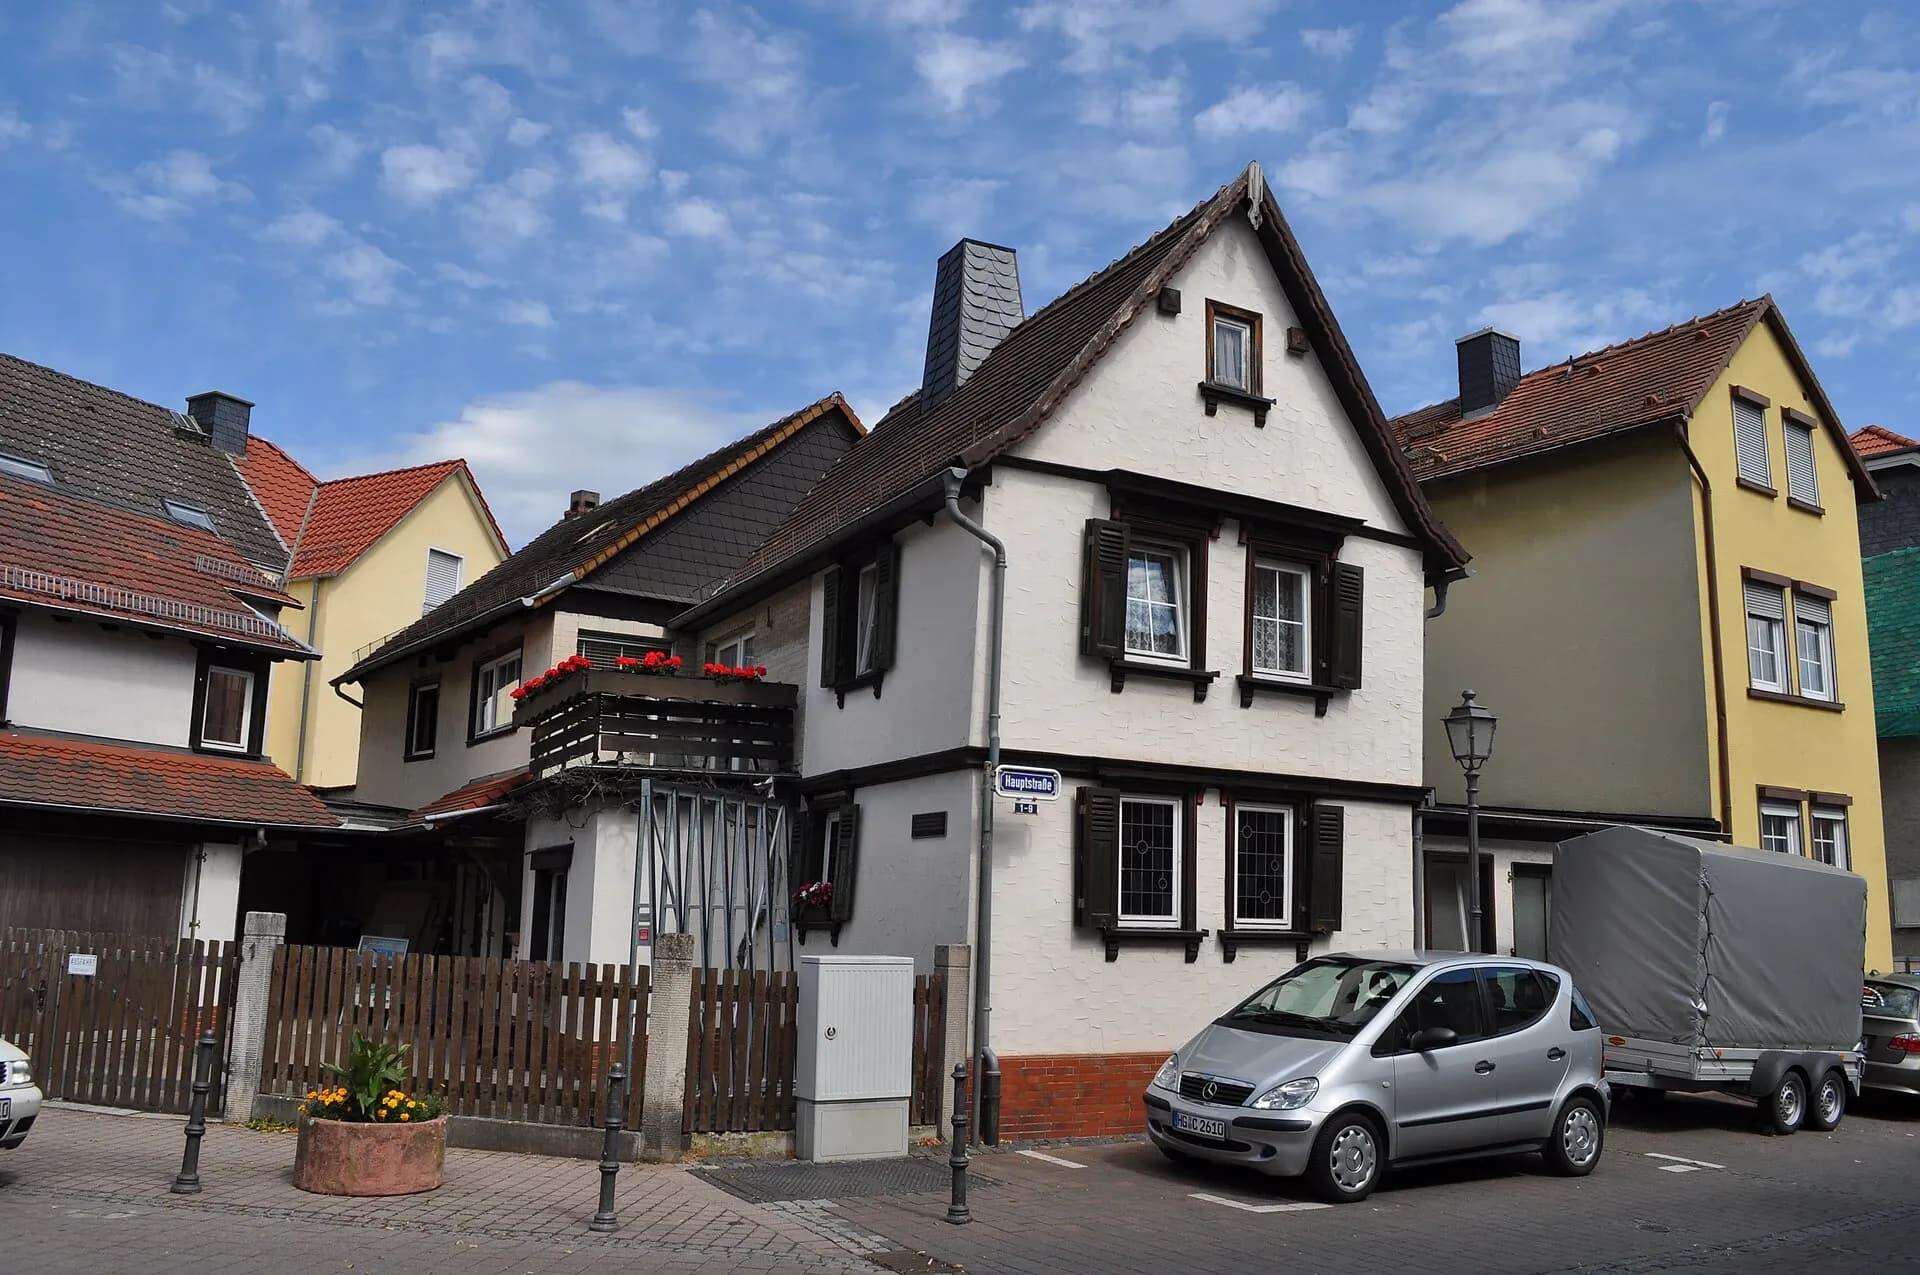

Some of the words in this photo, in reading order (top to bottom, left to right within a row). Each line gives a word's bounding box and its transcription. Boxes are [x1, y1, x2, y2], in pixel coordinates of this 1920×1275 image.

[1005, 774, 1052, 791] Hauptstraße
[1177, 1113, 1188, 1129] HG
[1192, 1118, 1198, 1130] C
[1200, 1120, 1224, 1136] 2610
